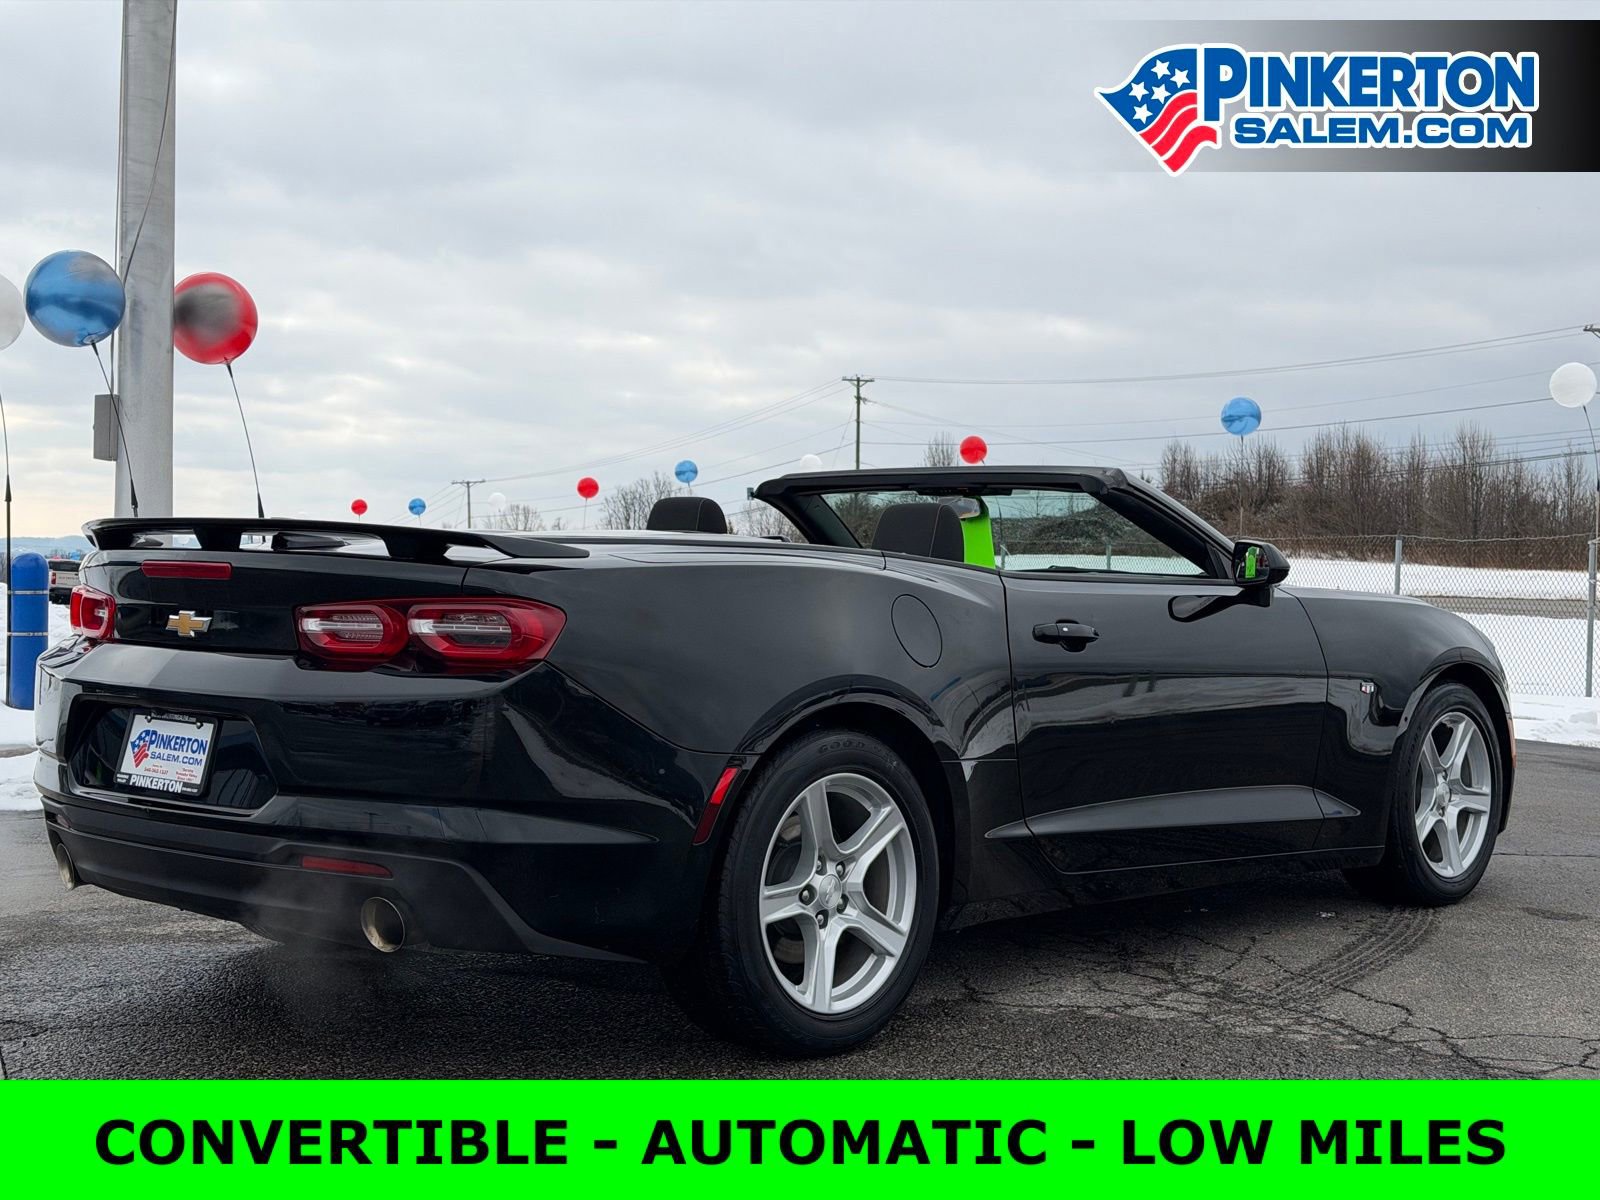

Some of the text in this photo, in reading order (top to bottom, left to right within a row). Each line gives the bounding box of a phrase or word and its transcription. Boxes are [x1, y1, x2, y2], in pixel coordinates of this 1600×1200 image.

[148, 729, 208, 756] PINKERTON
[150, 751, 203, 767] SALEM.COM
[129, 774, 183, 794] PINKERTON
